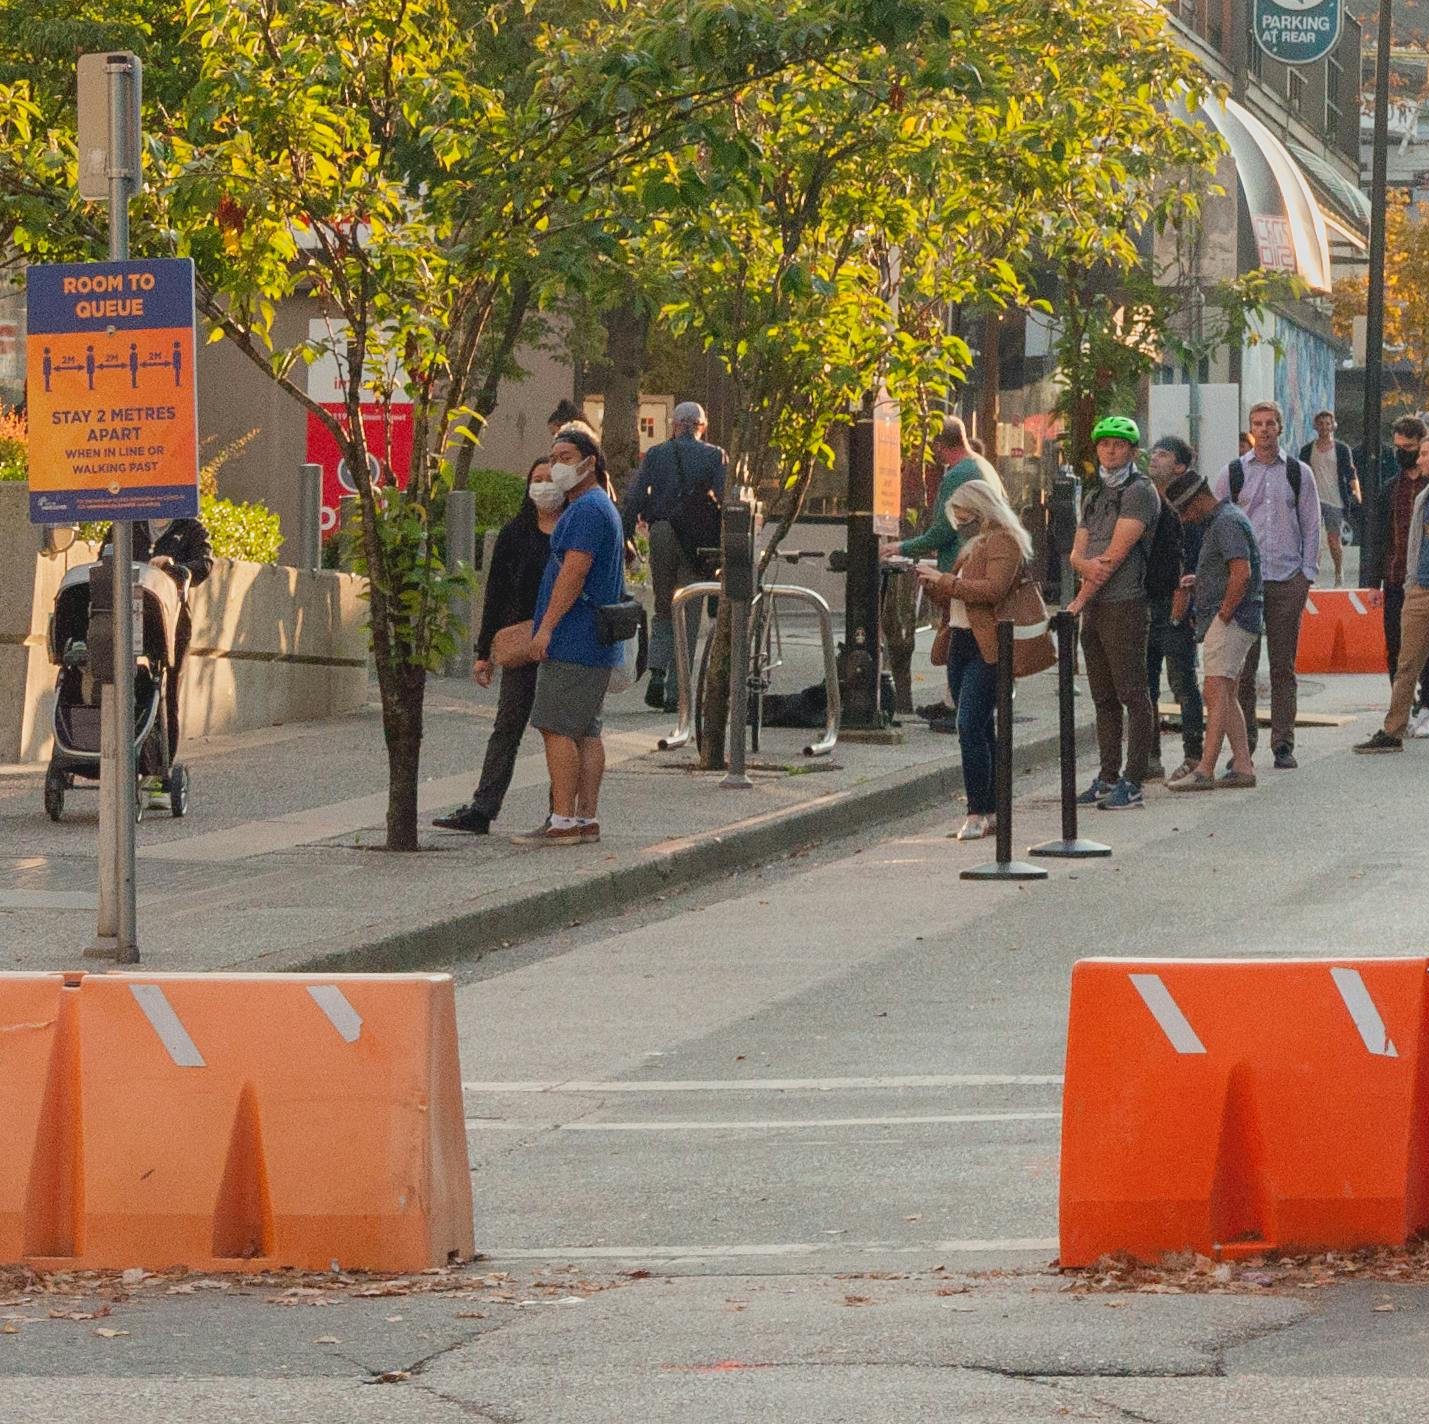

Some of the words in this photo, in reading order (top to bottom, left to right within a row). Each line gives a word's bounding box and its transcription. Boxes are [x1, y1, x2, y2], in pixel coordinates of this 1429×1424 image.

[1262, 15, 1330, 31] PARKING
[1262, 30, 1279, 43] AT
[1281, 31, 1316, 43] REAR
[63, 274, 123, 294] ROOM
[128, 273, 155, 290] TO
[75, 298, 144, 319] QUEUE
[62, 356, 75, 364] 2M
[105, 354, 118, 362] 2M
[149, 352, 162, 360] 2M
[52, 410, 92, 425] STAY
[97, 409, 106, 422] 2
[111, 406, 176, 421] METRES
[87, 427, 142, 442] APART
[65, 449, 100, 459] WHEN
[104, 448, 116, 457] IN
[119, 446, 145, 456] LINE
[147, 446, 165, 455] OR
[73, 463, 127, 474] WALKING
[129, 462, 158, 472] PAST
